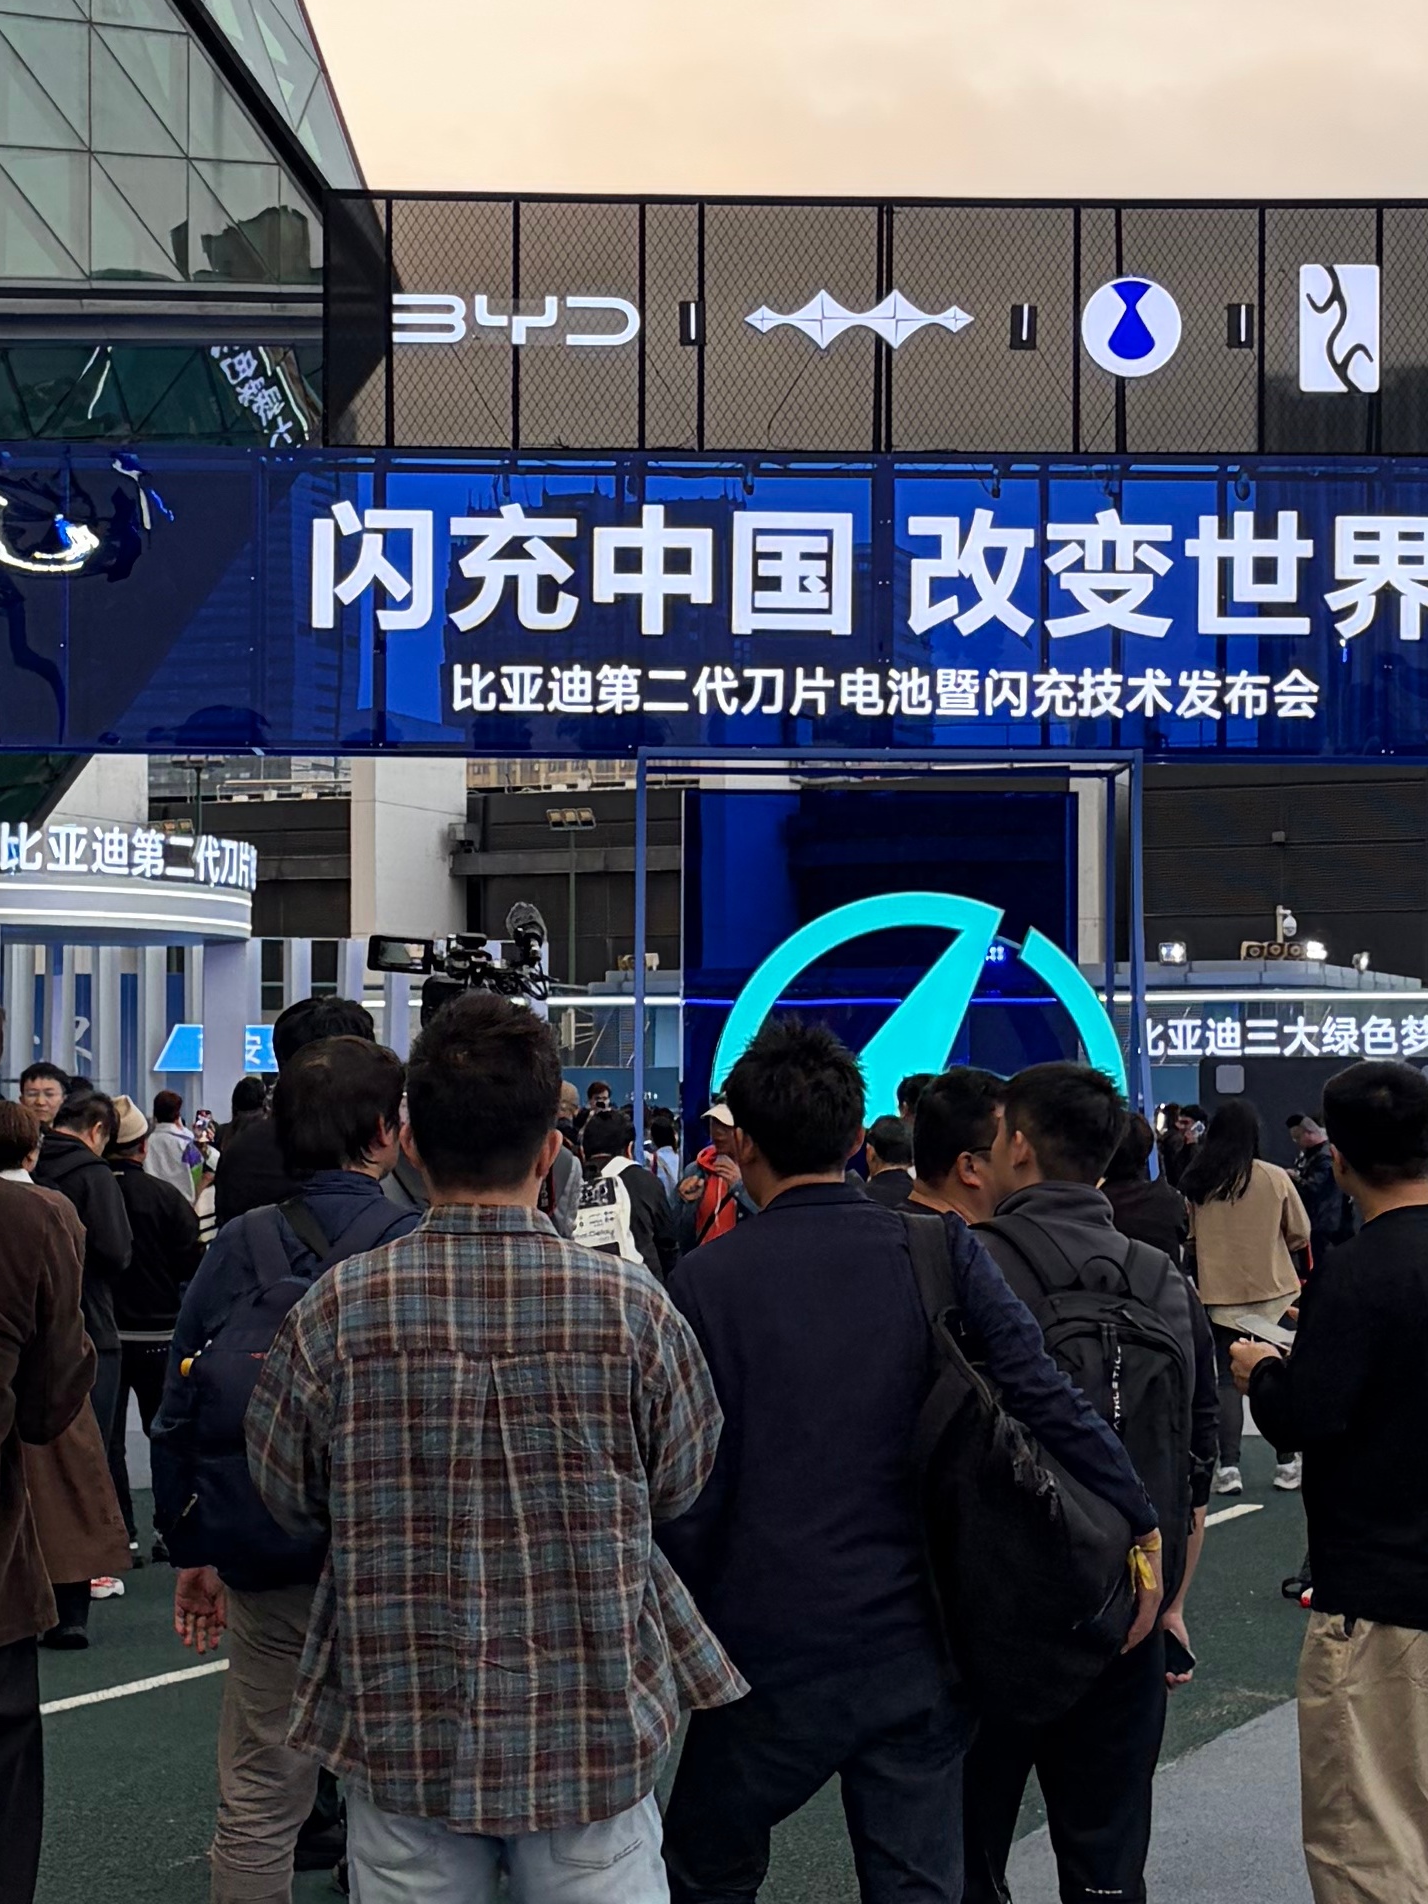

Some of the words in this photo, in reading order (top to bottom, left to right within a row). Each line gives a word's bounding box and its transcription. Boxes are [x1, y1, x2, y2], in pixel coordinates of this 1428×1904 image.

[392, 292, 640, 346] BYD
[311, 500, 854, 636] 闪充中国
[452, 663, 1320, 720] 比亚迪第二代刀片电池暨闪充技术发布会
